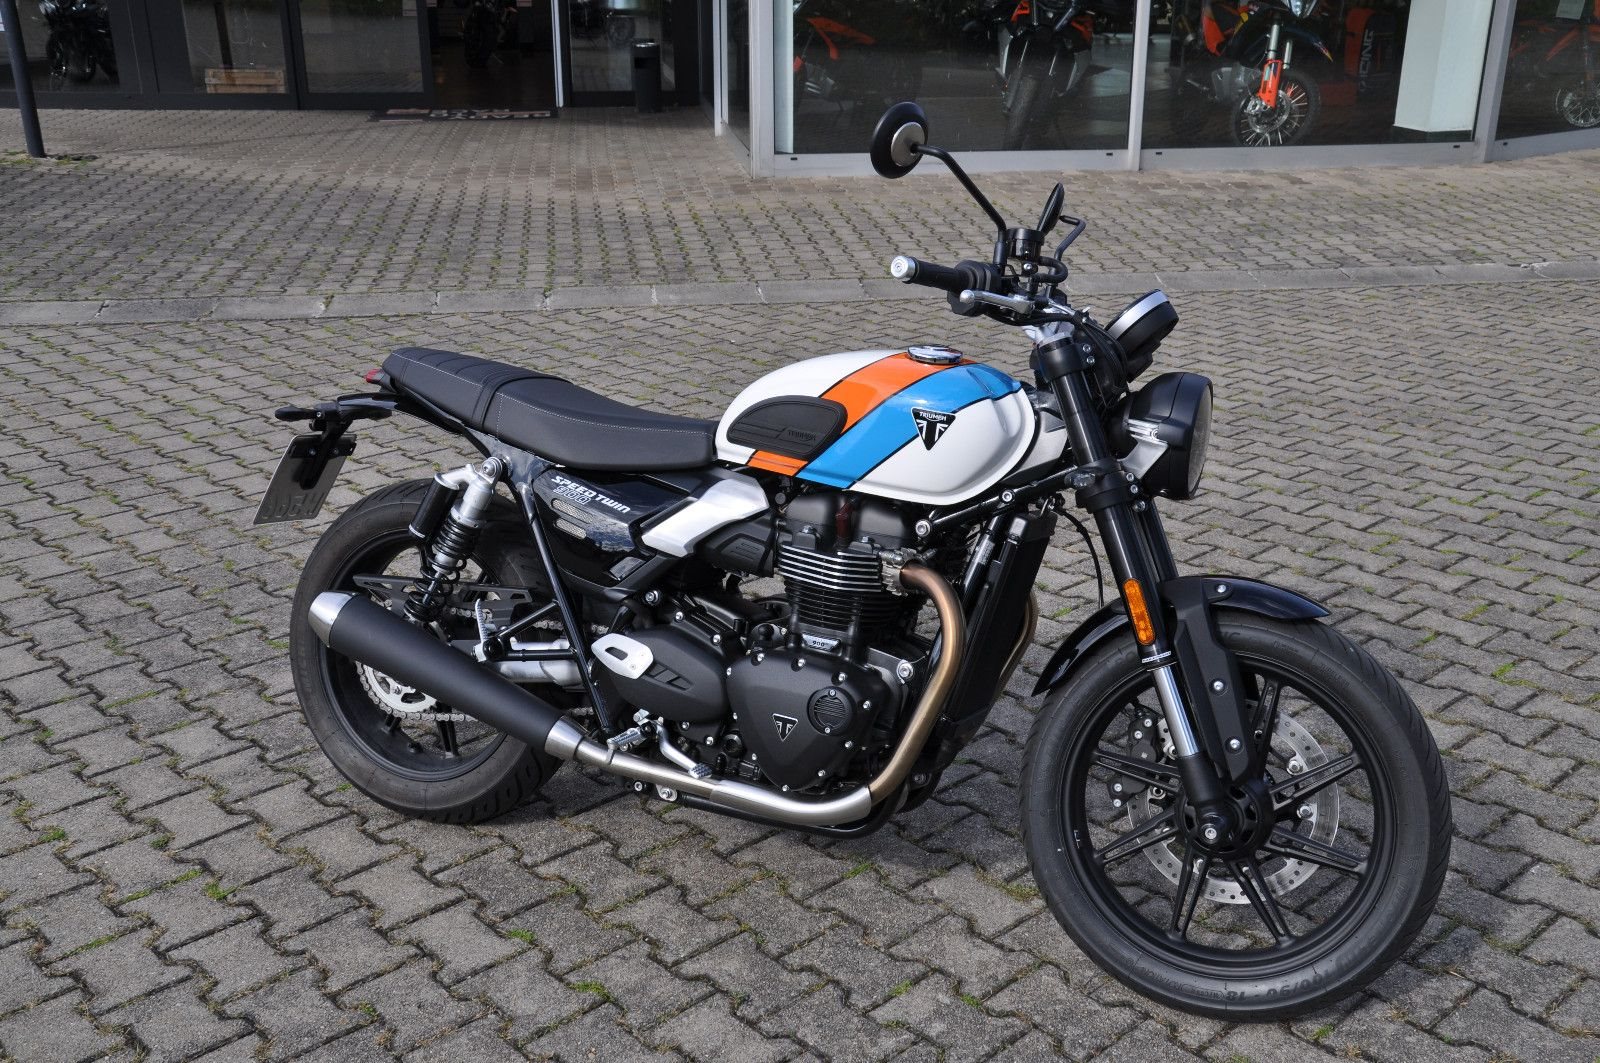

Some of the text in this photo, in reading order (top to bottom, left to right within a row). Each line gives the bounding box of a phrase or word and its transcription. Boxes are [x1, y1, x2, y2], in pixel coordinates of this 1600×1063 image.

[919, 411, 947, 421] TRIUMPH
[551, 475, 631, 514] SPEED TWIN
[552, 485, 592, 506] 900
